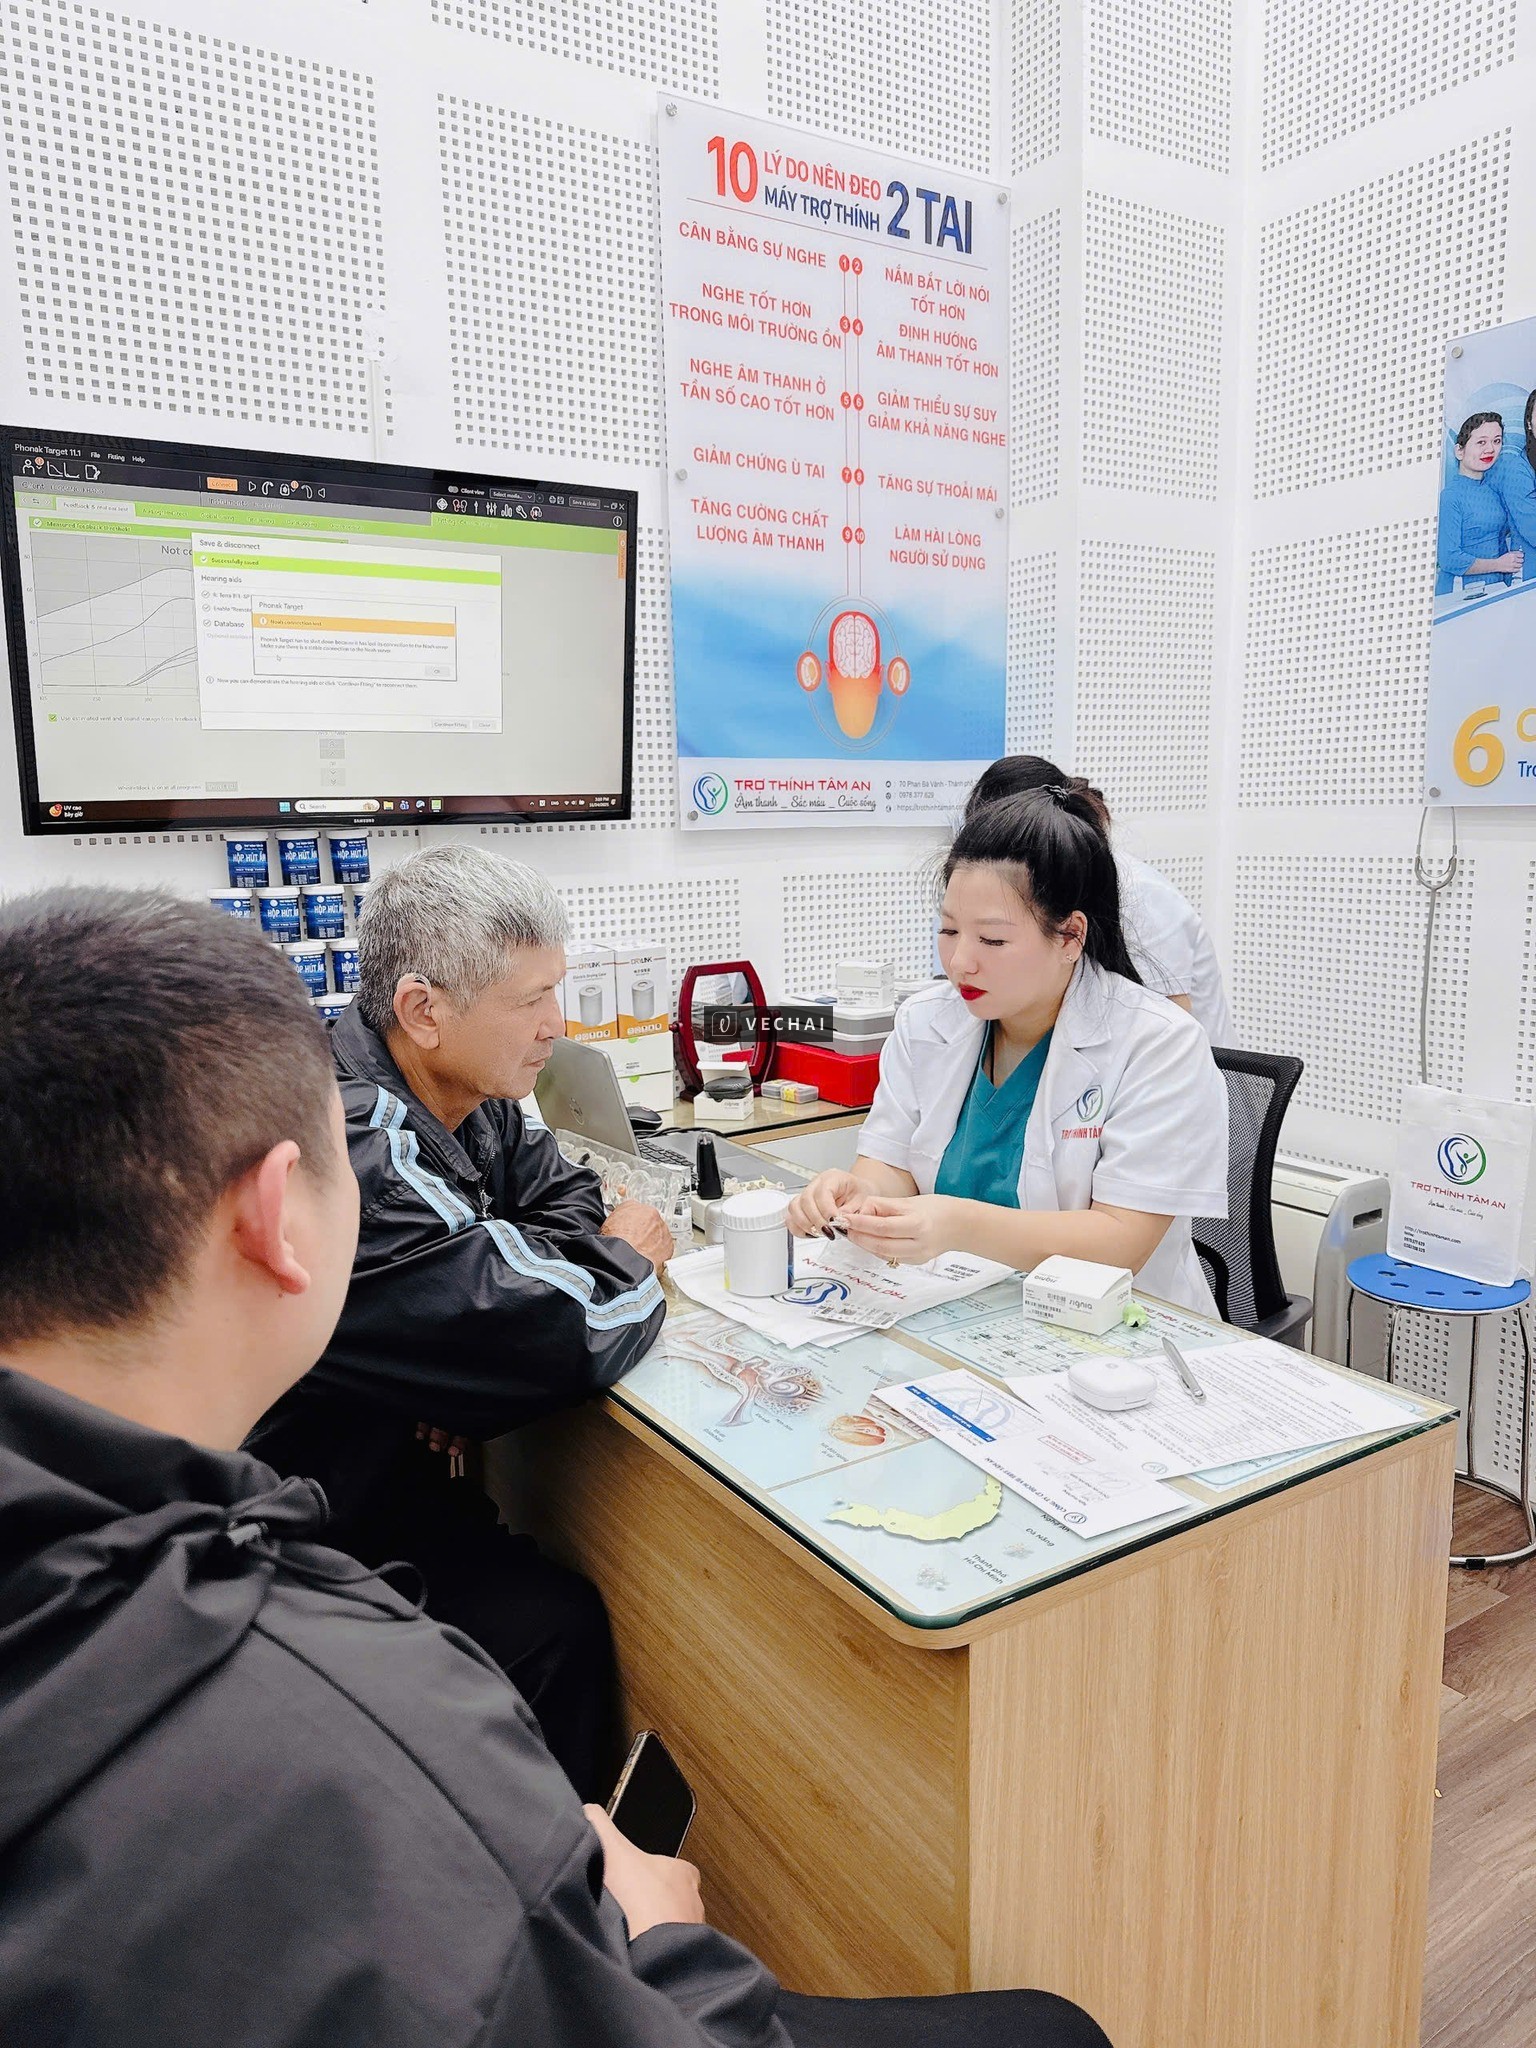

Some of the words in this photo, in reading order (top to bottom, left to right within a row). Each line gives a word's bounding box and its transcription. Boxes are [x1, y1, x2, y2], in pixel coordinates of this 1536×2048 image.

[708, 136, 758, 202] 10
[765, 150, 782, 175] LÝ
[786, 157, 808, 182] DO
[813, 163, 845, 192] NÊN
[849, 174, 881, 200] ĐEO
[765, 185, 797, 211] MÁY
[800, 194, 832, 224] TRỢ
[834, 203, 879, 232] THÍNH
[887, 181, 910, 239] 2
[916, 187, 972, 255] TAI
[680, 221, 710, 242] CÂN
[717, 226, 758, 252] BẰNG
[763, 241, 782, 260] SỰ
[787, 247, 826, 267] NGHE
[886, 265, 912, 285] NẮM
[918, 272, 941, 291] BẮT
[947, 280, 965, 297] LỜI
[970, 286, 989, 302] NÓI
[703, 283, 744, 304] NGHE
[750, 291, 777, 310] TỐT
[782, 300, 811, 318] HƠN
[911, 295, 935, 314] TỐT
[940, 304, 964, 320] HƠN
[669, 303, 722, 326] TRONG
[728, 314, 753, 332] MÔI
[759, 321, 817, 344] TRƯỜNG
[823, 328, 840, 349] ỒN
[899, 324, 929, 341] ĐỊNH
[934, 331, 977, 350] HƯỚNG
[877, 340, 895, 359] ÂM
[900, 348, 941, 367] THANH
[946, 355, 969, 372] TỐT
[974, 362, 998, 377] HƠN
[691, 358, 732, 378] NGHE
[738, 364, 758, 383] ÂM
[763, 372, 810, 392] THANH
[816, 376, 825, 394] Ở
[681, 379, 710, 400] TẦN
[716, 386, 735, 404] SỐ
[741, 393, 770, 410] CAO
[774, 397, 800, 415] TỐT
[806, 404, 834, 420] HƠN
[878, 390, 909, 408] GIẢM
[914, 395, 949, 415] THIỂU
[954, 404, 970, 418] SỰ
[974, 408, 996, 422] SUY
[868, 411, 900, 431] GIẢM
[905, 420, 929, 435] KHẢ
[935, 425, 968, 441] NĂNG
[973, 431, 1005, 446] NGHE
[14, 444, 44, 454] Phonak
[44, 446, 68, 456] Target
[694, 444, 730, 465] GIẢM
[736, 453, 786, 473] CHỨNG
[792, 461, 800, 475] Ù
[805, 464, 824, 478] TAI
[878, 476, 912, 492] TĂNG
[917, 481, 933, 494] SỰ
[937, 483, 972, 498] THOẢI
[977, 488, 996, 501] MÁI
[691, 497, 731, 516] TĂNG
[737, 504, 787, 523] CƯỜNG
[792, 509, 828, 527] CHẤT
[161, 544, 180, 555] Not
[200, 539, 215, 548] Save
[224, 541, 260, 550] disconnect
[698, 525, 747, 544] LƯỢNG
[753, 528, 772, 546] ÂM
[778, 535, 824, 551] THANH
[896, 527, 920, 541] LÀM
[925, 530, 943, 543] HÀI
[949, 532, 980, 546] LÒNG
[212, 558, 243, 566] Successfully
[890, 550, 928, 565] NGƯỜI
[932, 554, 948, 567] SỬ
[953, 556, 985, 569] DỤNG
[201, 574, 227, 583] Hearing
[284, 603, 303, 611] Target
[214, 620, 244, 628] Database
[1453, 704, 1504, 786] 6
[734, 778, 765, 793] TRỢ
[768, 776, 814, 790] THÍNH
[818, 777, 848, 790] TÂM
[851, 781, 870, 791] AN
[1411, 1181, 1431, 1193] TRỢ
[1433, 1187, 1464, 1199] THÍNH
[1467, 1193, 1489, 1205] TÂM
[1491, 1200, 1505, 1209] AN
[1069, 1299, 1092, 1310] signia
[1036, 1534, 1054, 1547] Nẵng
[972, 1554, 993, 1569] Thành
[985, 1572, 1003, 1584] Minh
